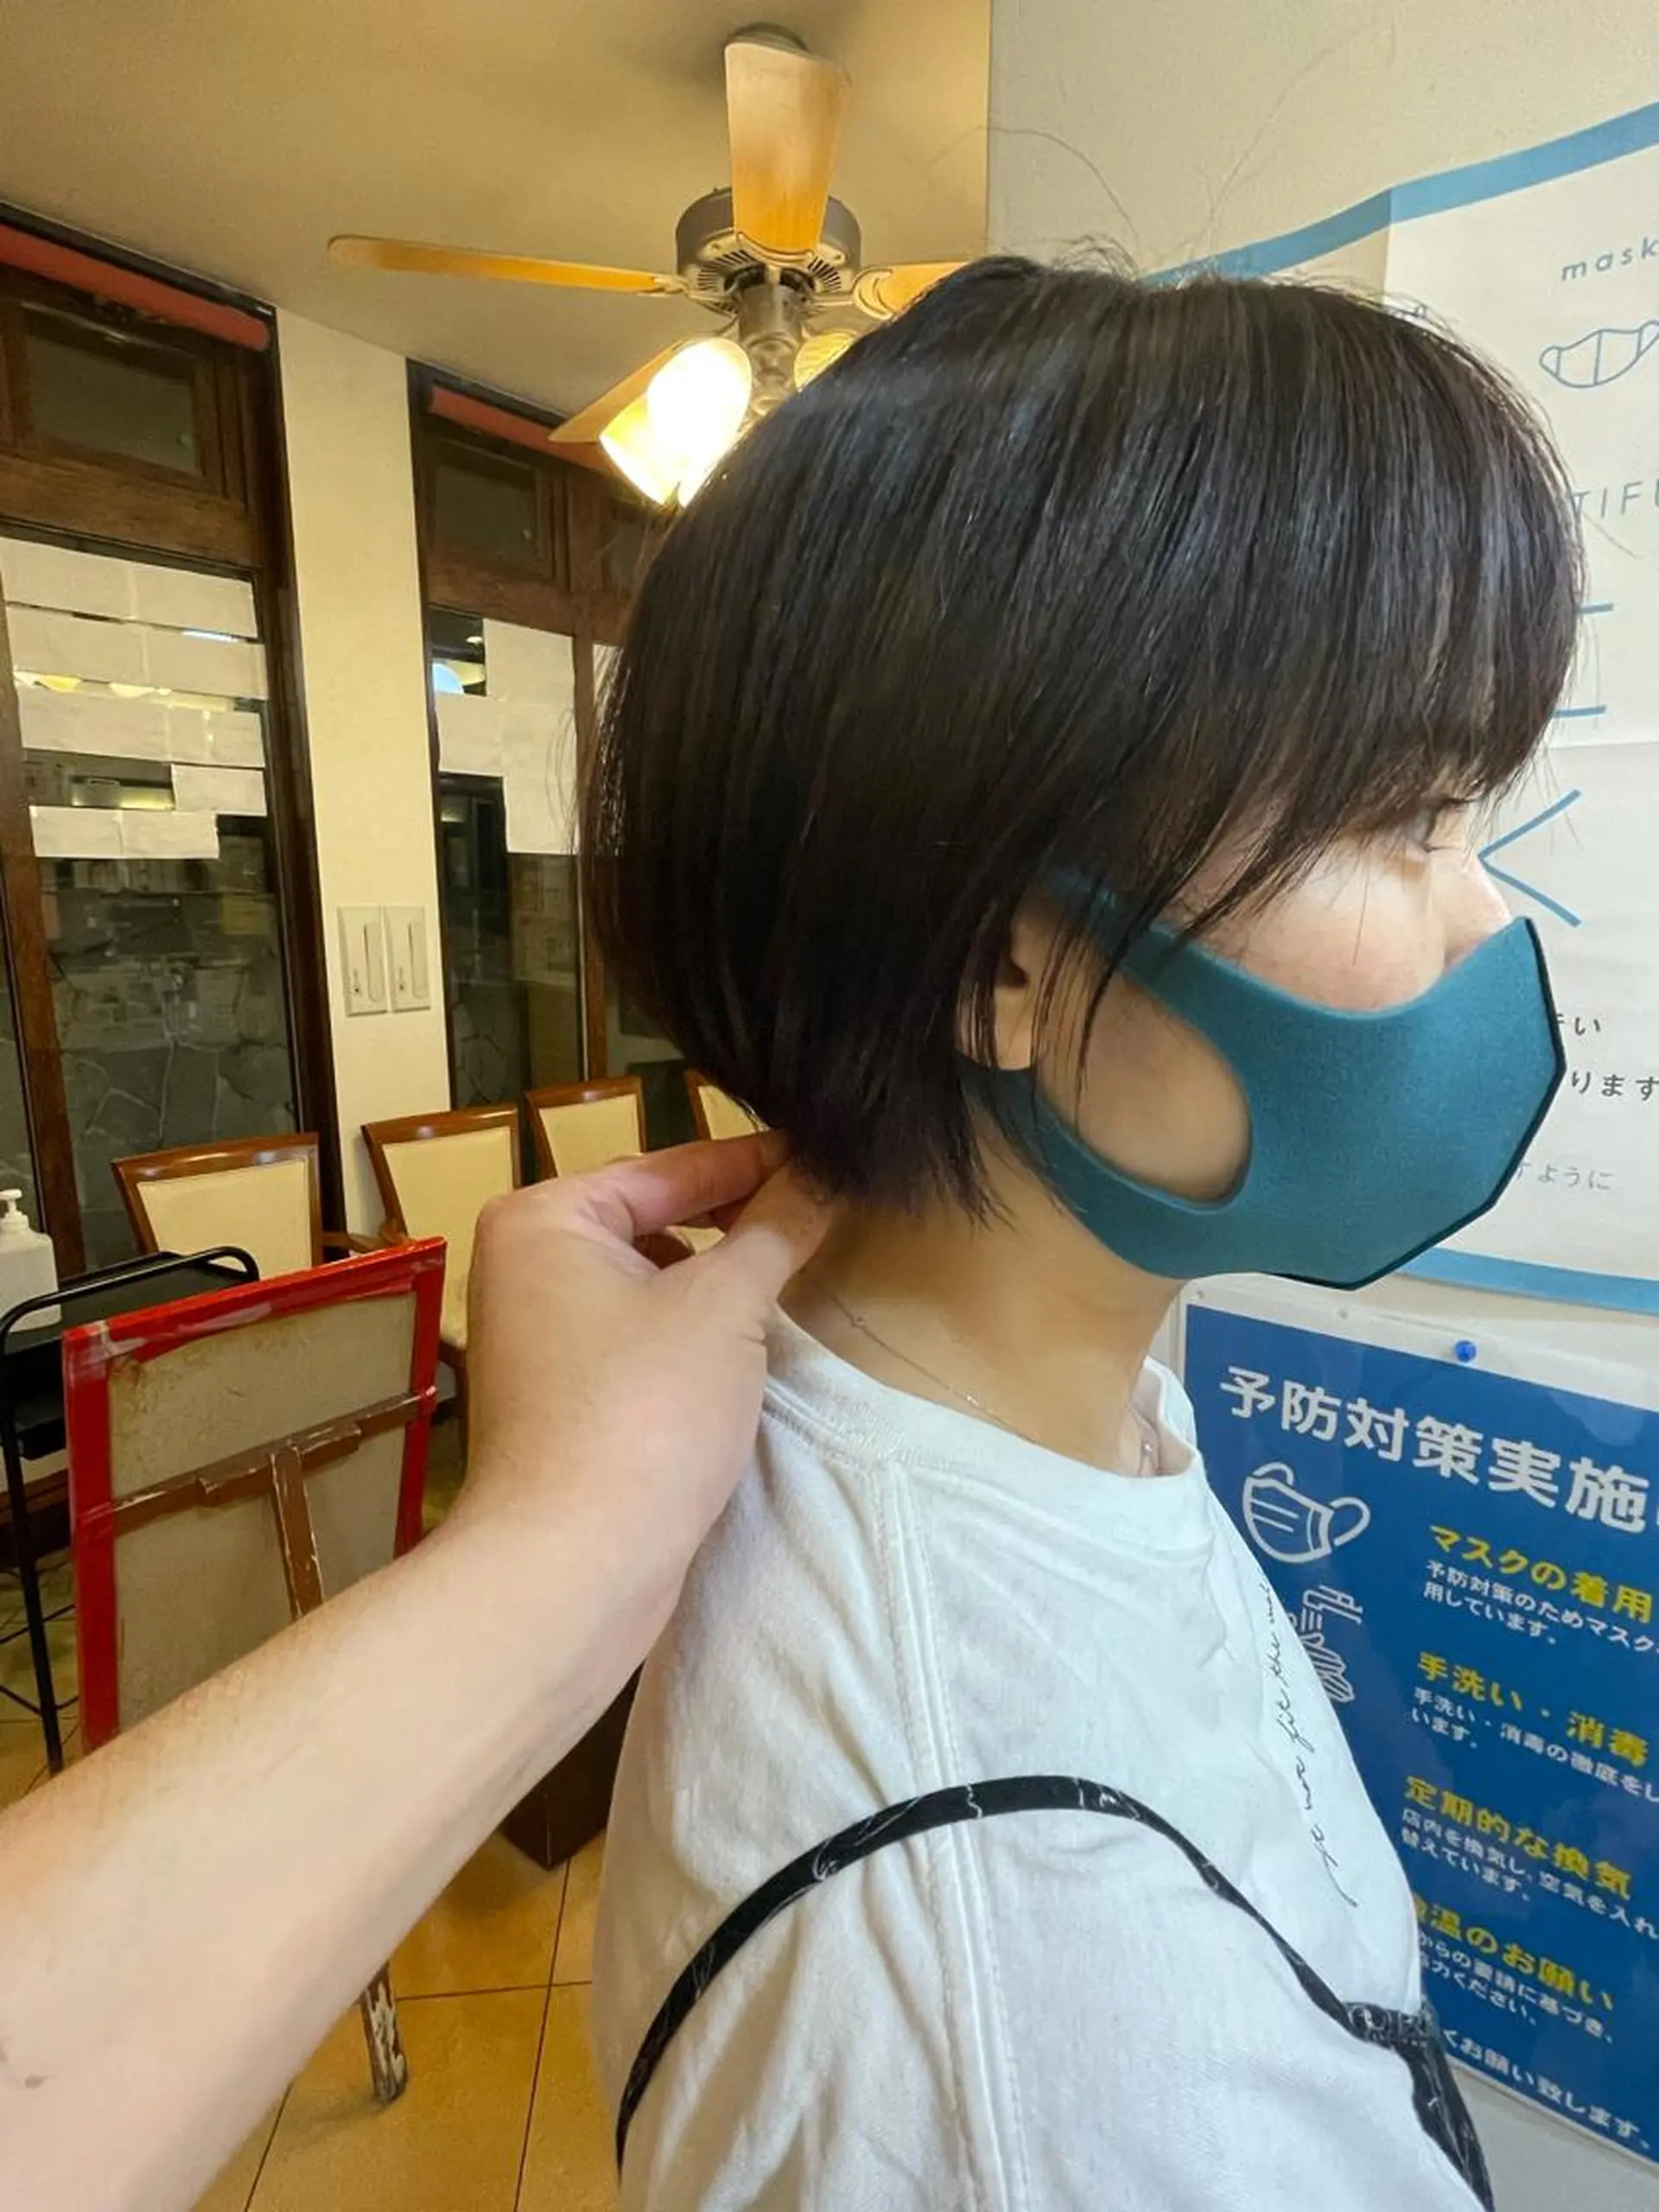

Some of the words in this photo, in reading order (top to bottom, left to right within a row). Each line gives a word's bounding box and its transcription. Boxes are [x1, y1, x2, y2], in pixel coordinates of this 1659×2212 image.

[1561, 237, 1659, 281] mask
[1572, 478, 1659, 518] TIF
[1219, 1366, 1659, 1533] 予防対策実施
[1429, 1524, 1653, 1624] マスクの着用
[1404, 1775, 1631, 1901] 定期的な換気
